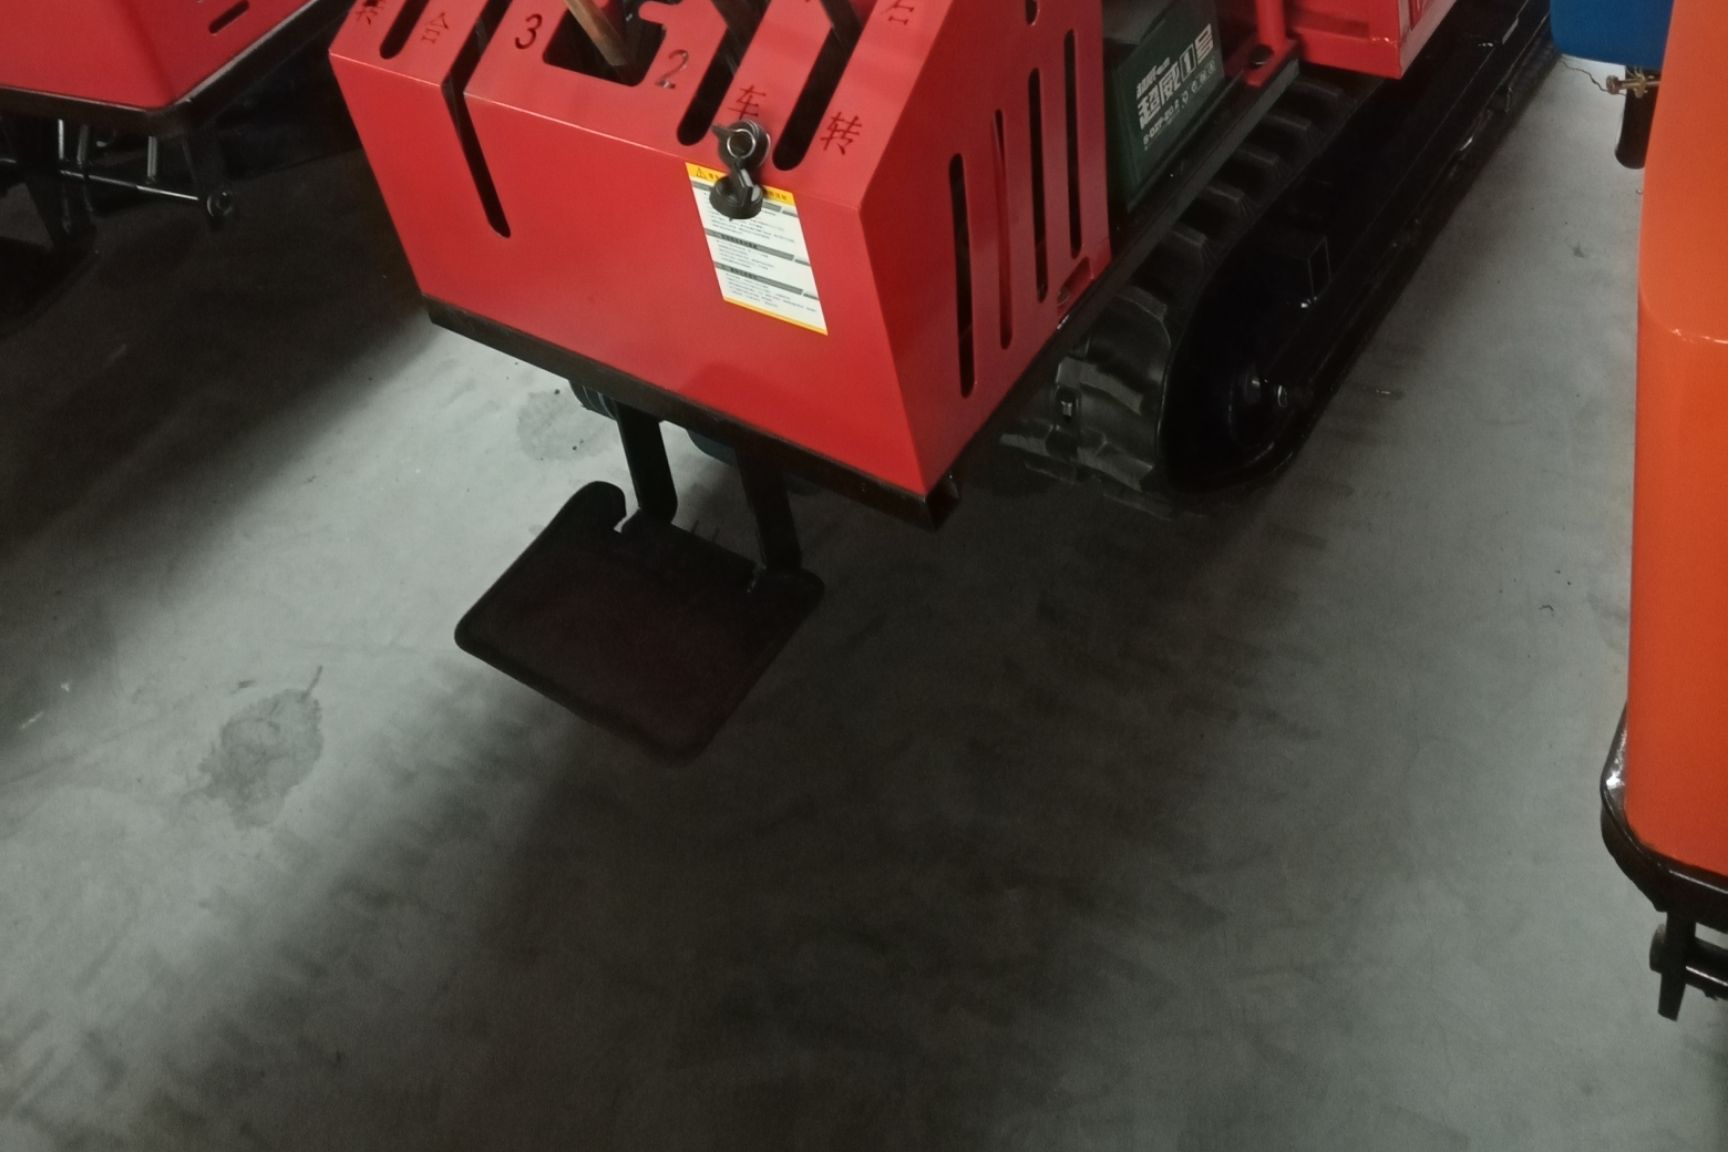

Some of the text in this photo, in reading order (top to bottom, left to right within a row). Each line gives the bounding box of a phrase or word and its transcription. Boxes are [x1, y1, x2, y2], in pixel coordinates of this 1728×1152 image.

[420, 11, 450, 44] 合
[514, 13, 543, 50] 3
[655, 49, 689, 90] 2
[727, 85, 767, 121] 车
[819, 111, 863, 156] 转
